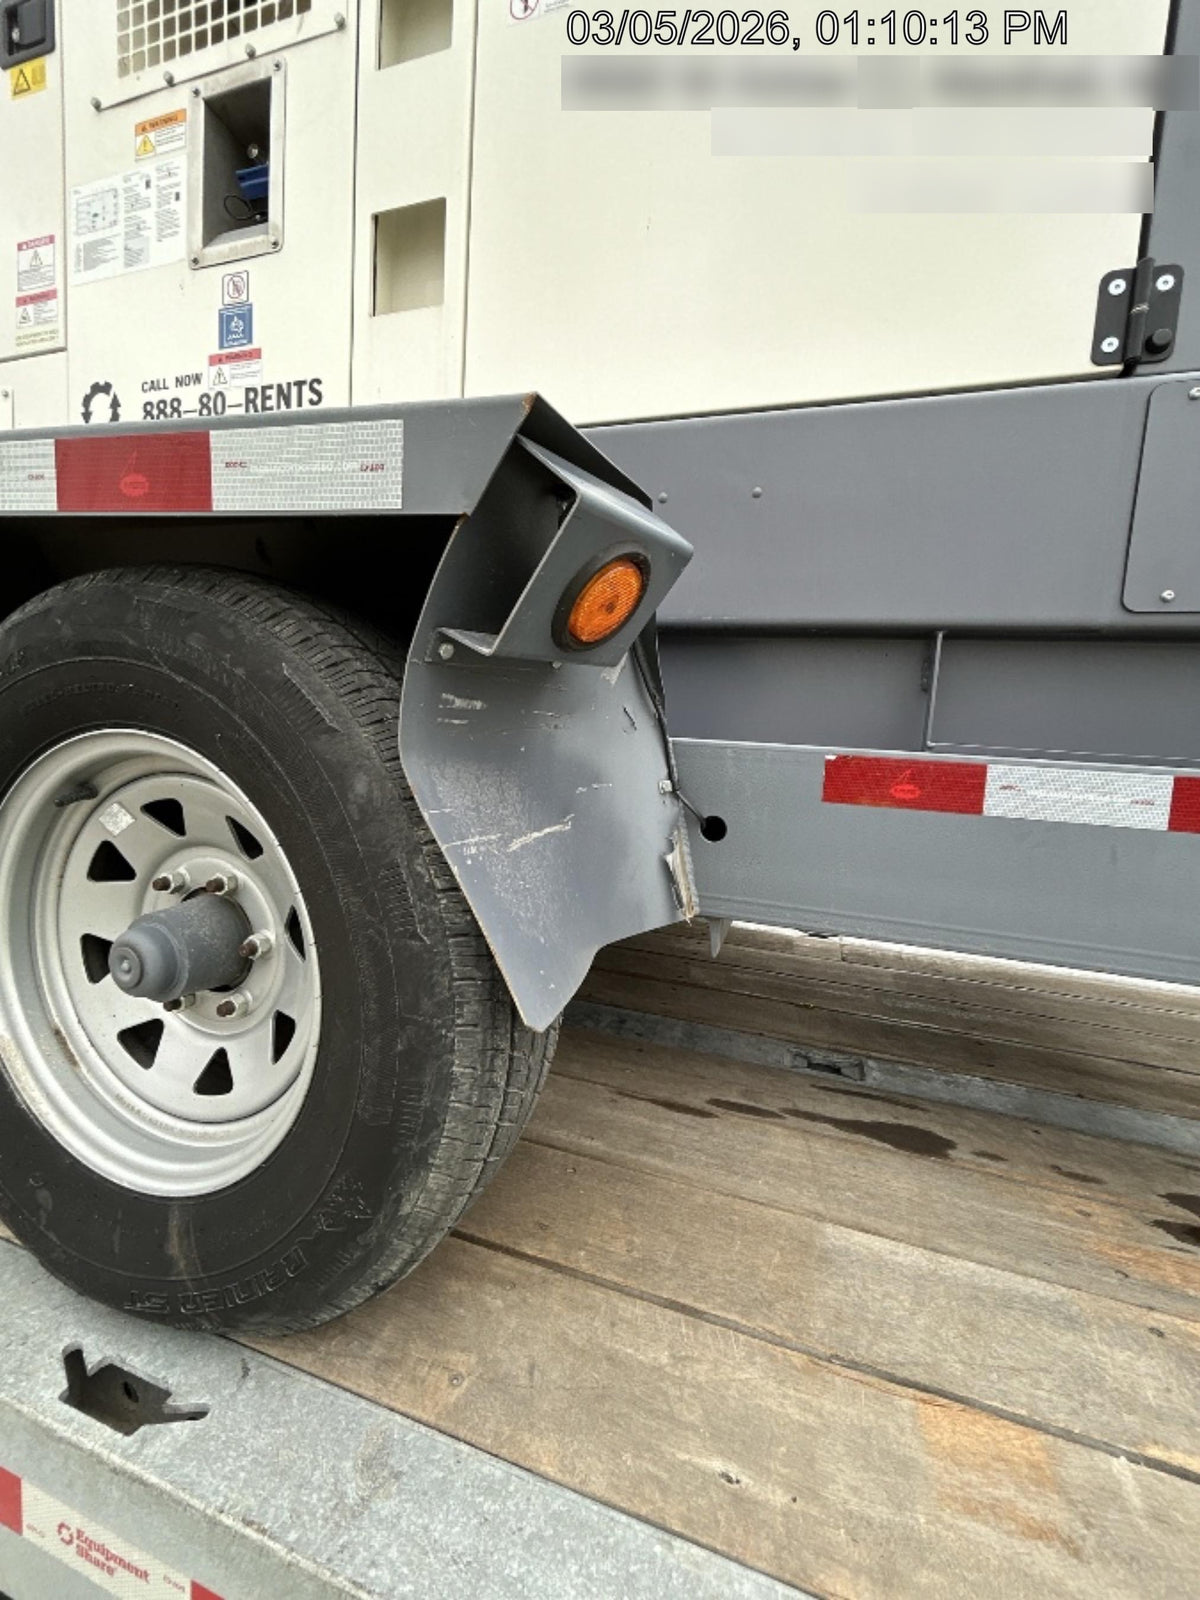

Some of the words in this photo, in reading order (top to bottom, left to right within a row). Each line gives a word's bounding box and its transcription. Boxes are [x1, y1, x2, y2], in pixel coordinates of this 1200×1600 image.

[141, 380, 169, 393] CALL
[175, 373, 203, 388] NOW
[76, 1527, 151, 1584] Equipment
